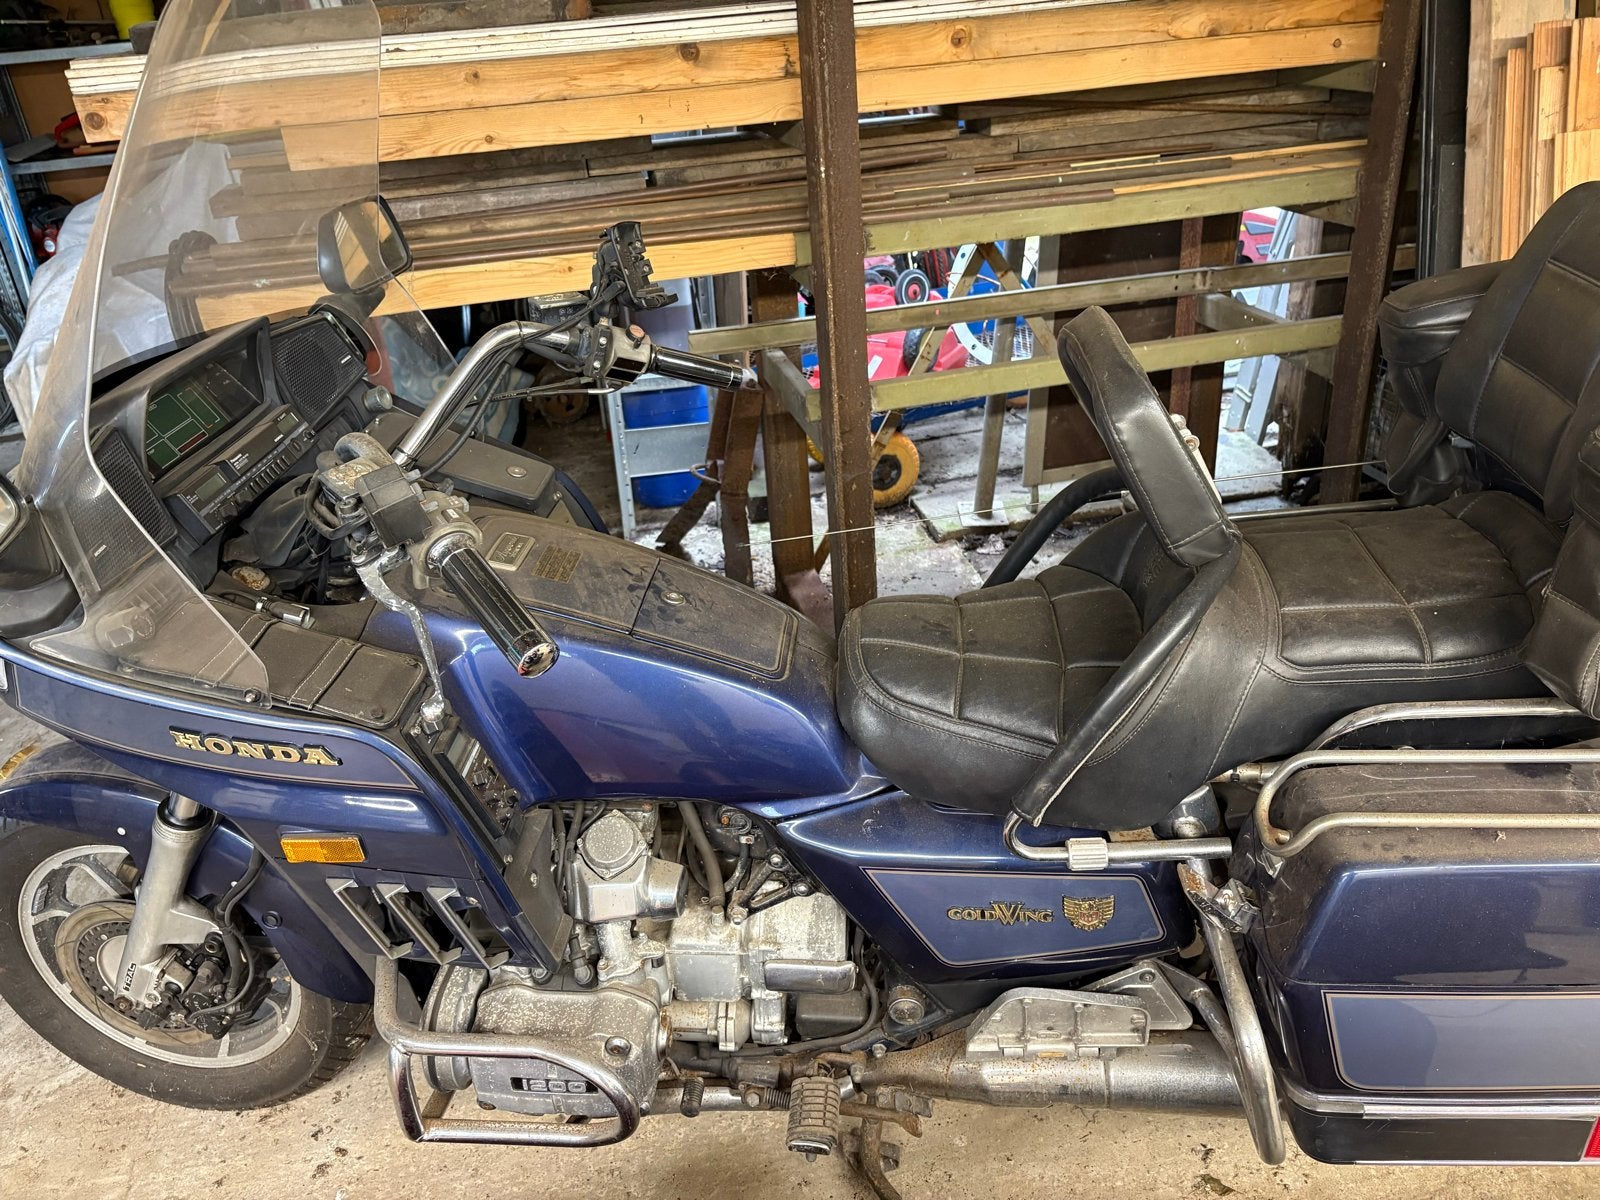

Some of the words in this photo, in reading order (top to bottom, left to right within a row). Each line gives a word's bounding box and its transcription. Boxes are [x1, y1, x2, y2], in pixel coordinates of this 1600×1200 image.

[169, 728, 341, 767] HONDA
[123, 962, 137, 992] TRAC
[522, 1079, 586, 1093] 1200
